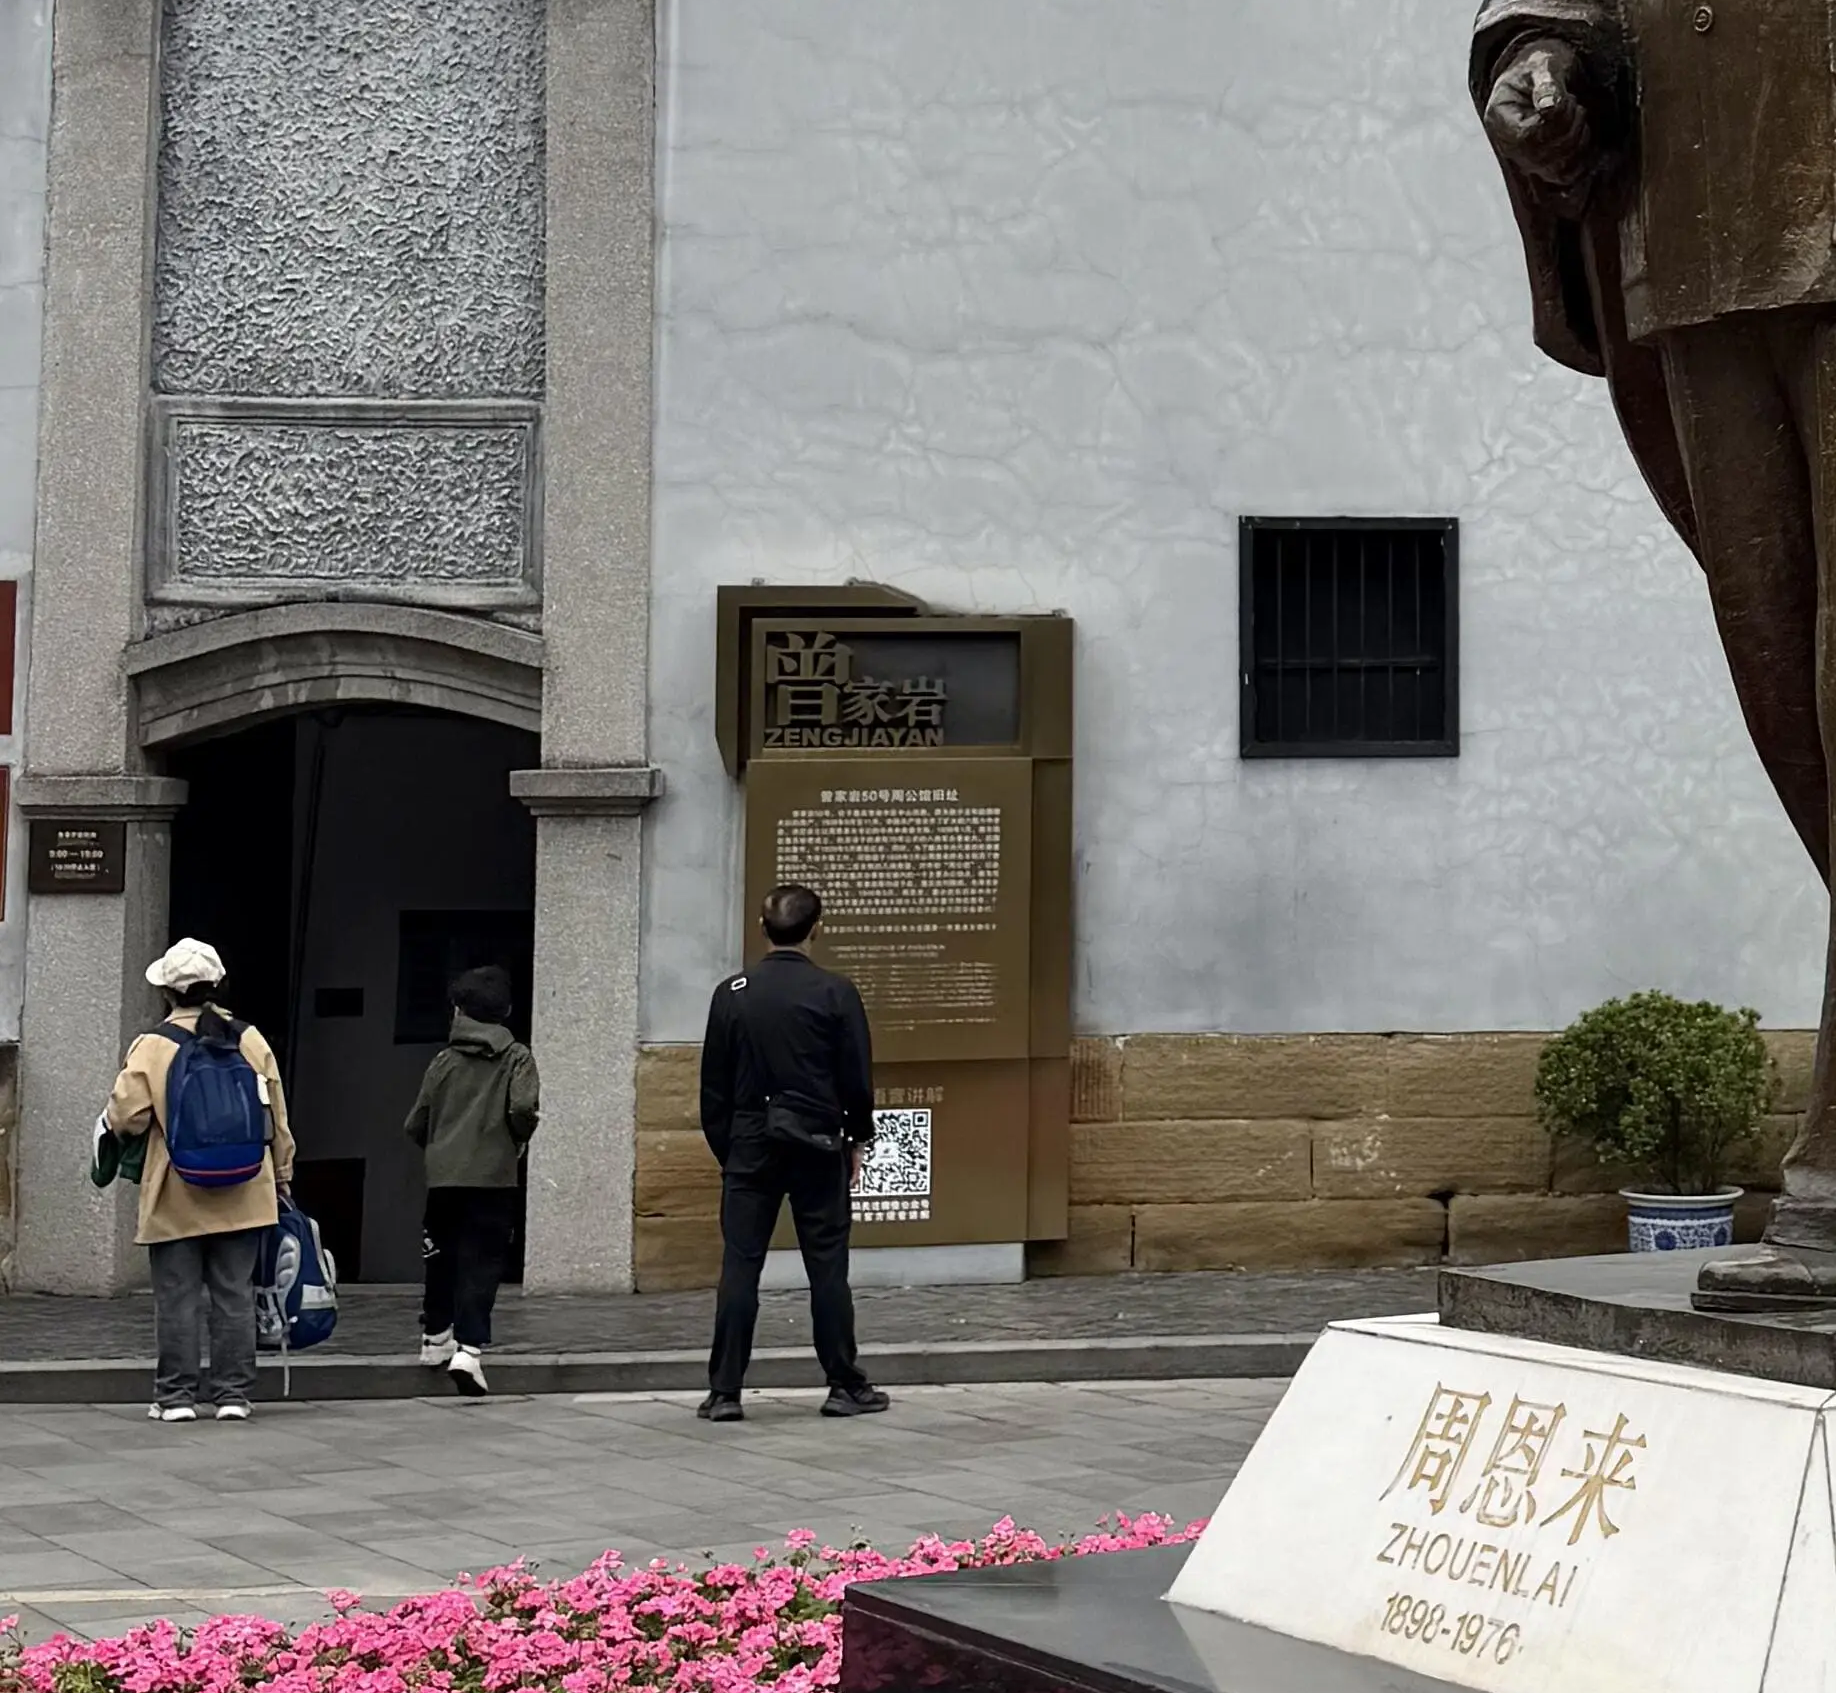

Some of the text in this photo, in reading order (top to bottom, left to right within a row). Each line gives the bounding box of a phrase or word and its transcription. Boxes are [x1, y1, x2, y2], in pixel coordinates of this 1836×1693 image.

[766, 631, 949, 727] 曾家岩
[764, 727, 945, 748] ZENGJIAYAN
[1379, 1381, 1648, 1547] 周恩来
[1380, 1591, 1523, 1666] 1898-1976
